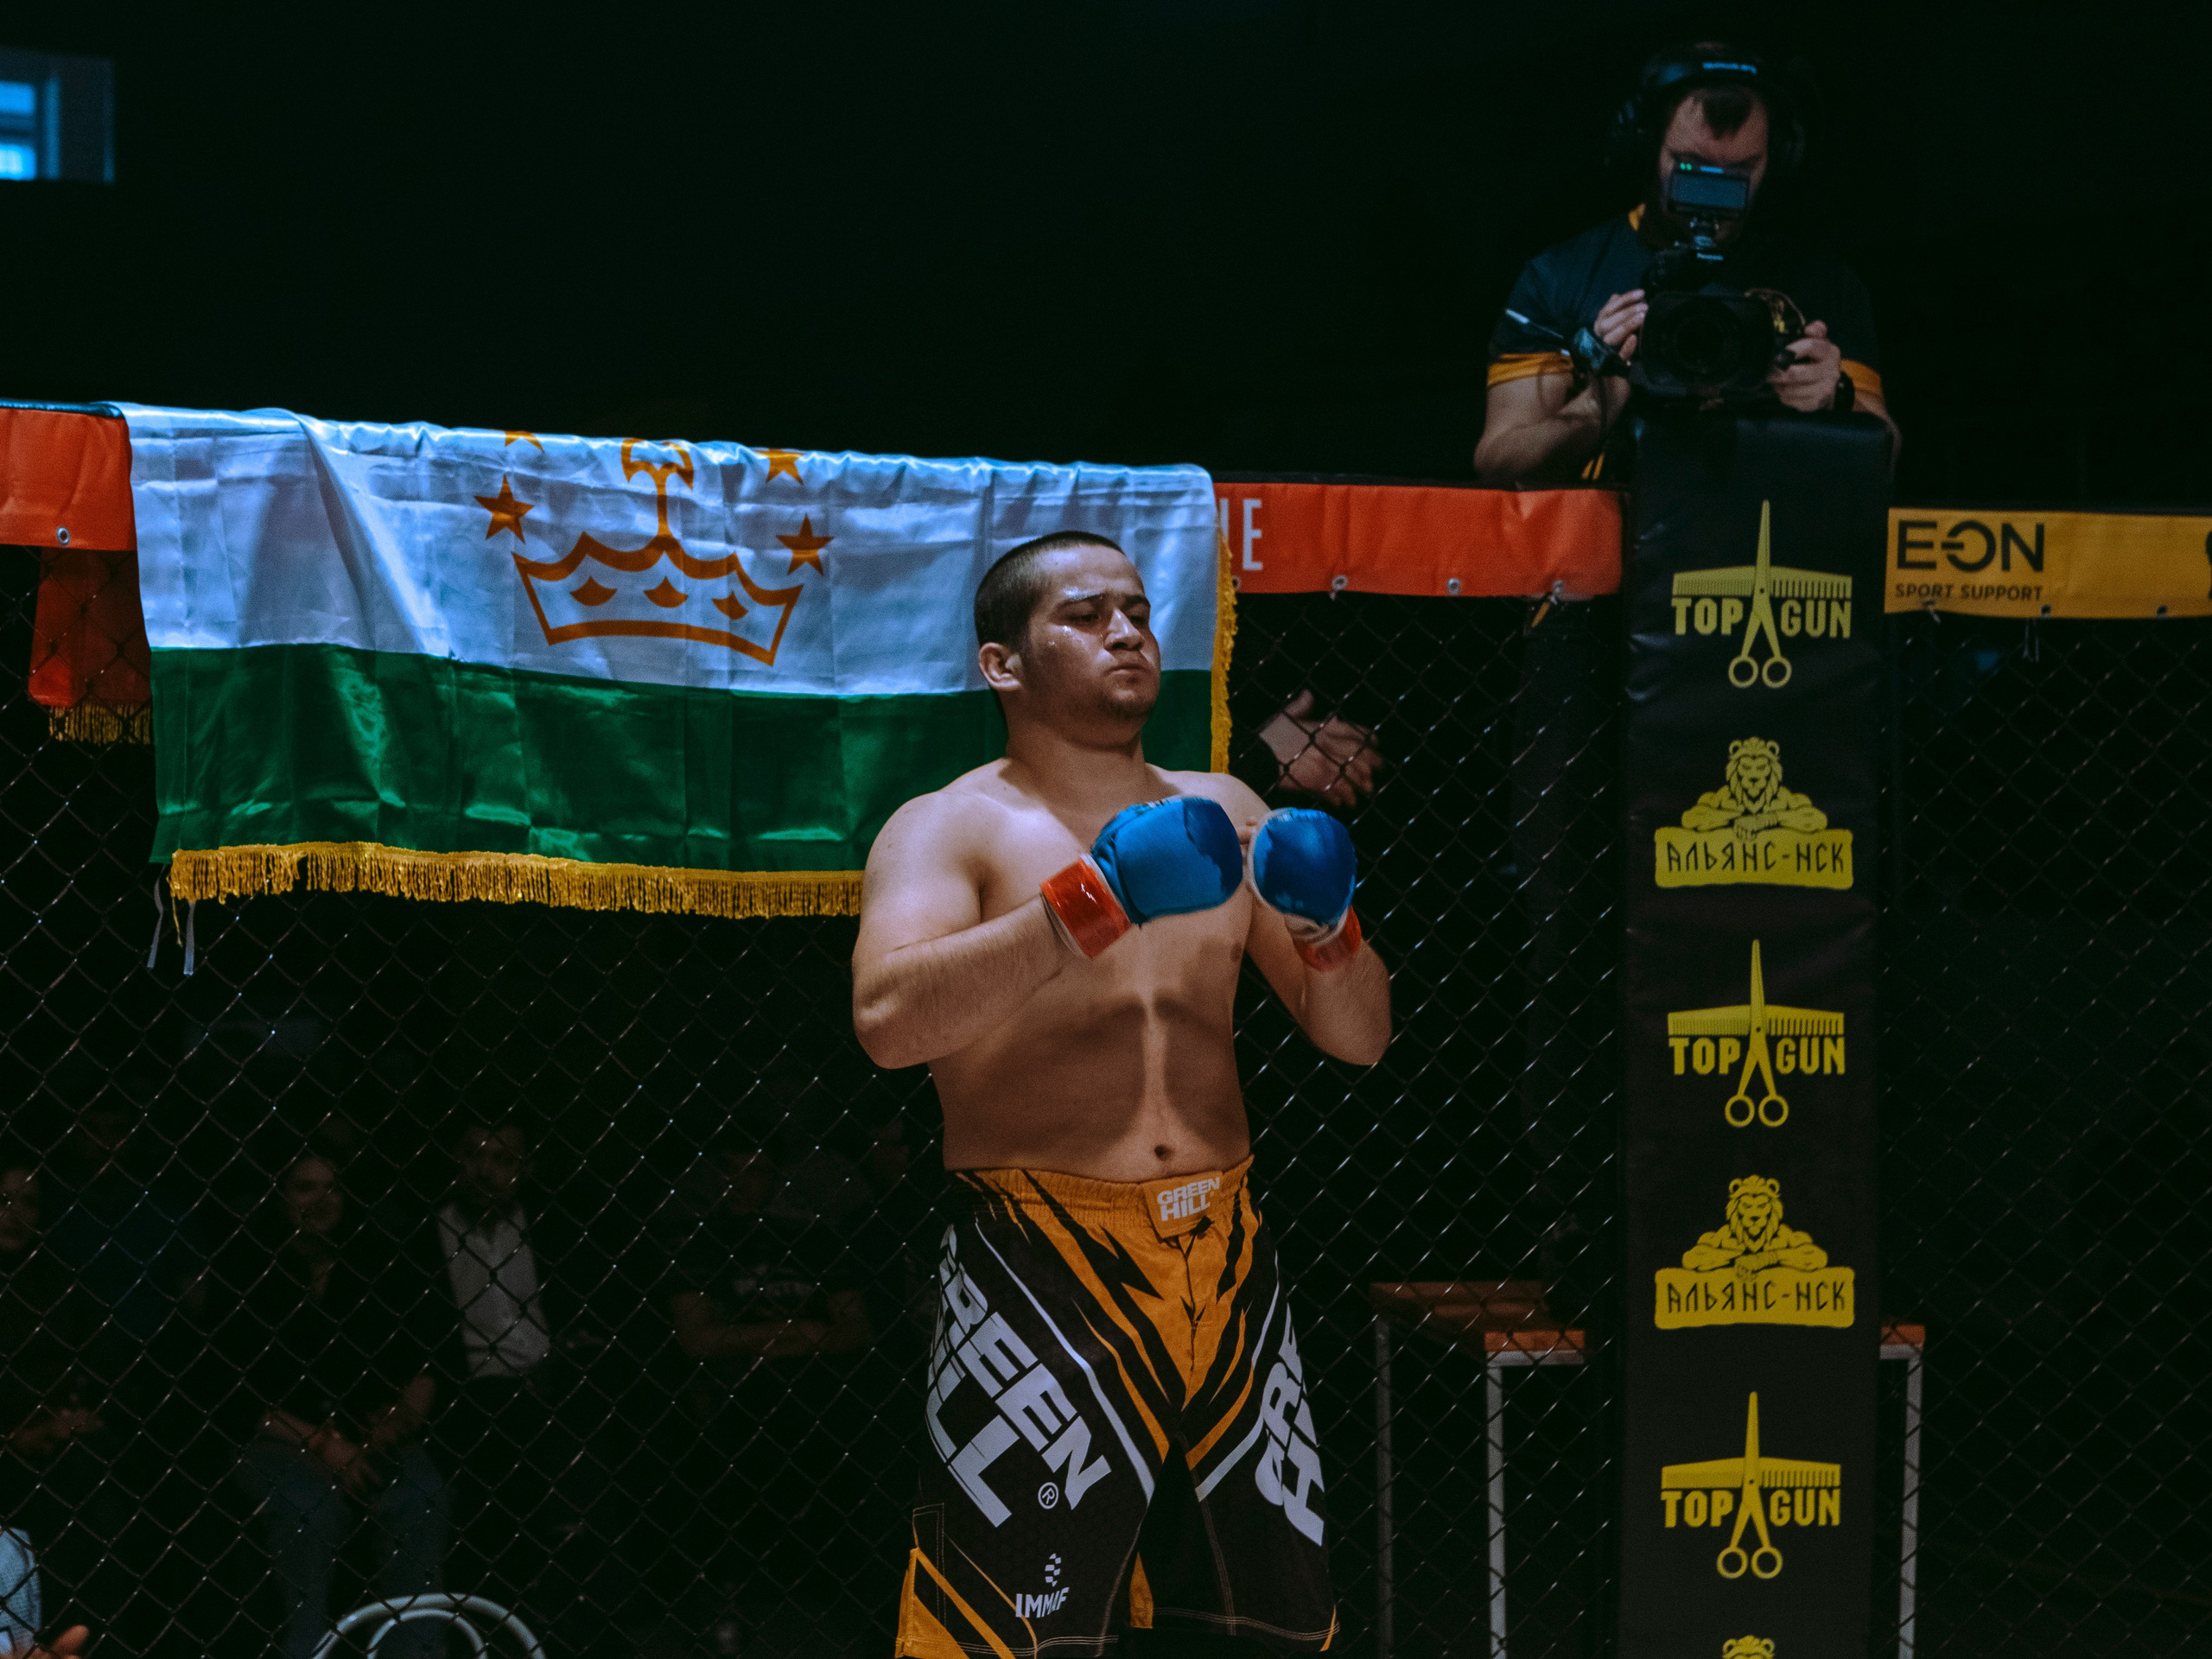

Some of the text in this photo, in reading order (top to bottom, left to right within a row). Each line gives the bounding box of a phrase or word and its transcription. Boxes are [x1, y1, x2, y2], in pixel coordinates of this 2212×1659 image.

[1897, 520, 2044, 572] EON
[1895, 583, 2043, 601] SPORT SUPPORT
[1671, 597, 1852, 639] TOP GUN
[1666, 841, 1844, 873] АЛЬЯНС-НСК
[1669, 1036, 1846, 1075] TOP GUN
[1157, 1176, 1220, 1205] GREEN
[1160, 1193, 1211, 1222] HILL
[1667, 1281, 1845, 1313] АЛЬЯНС-НСК
[1661, 1488, 1841, 1528] TOP GUN
